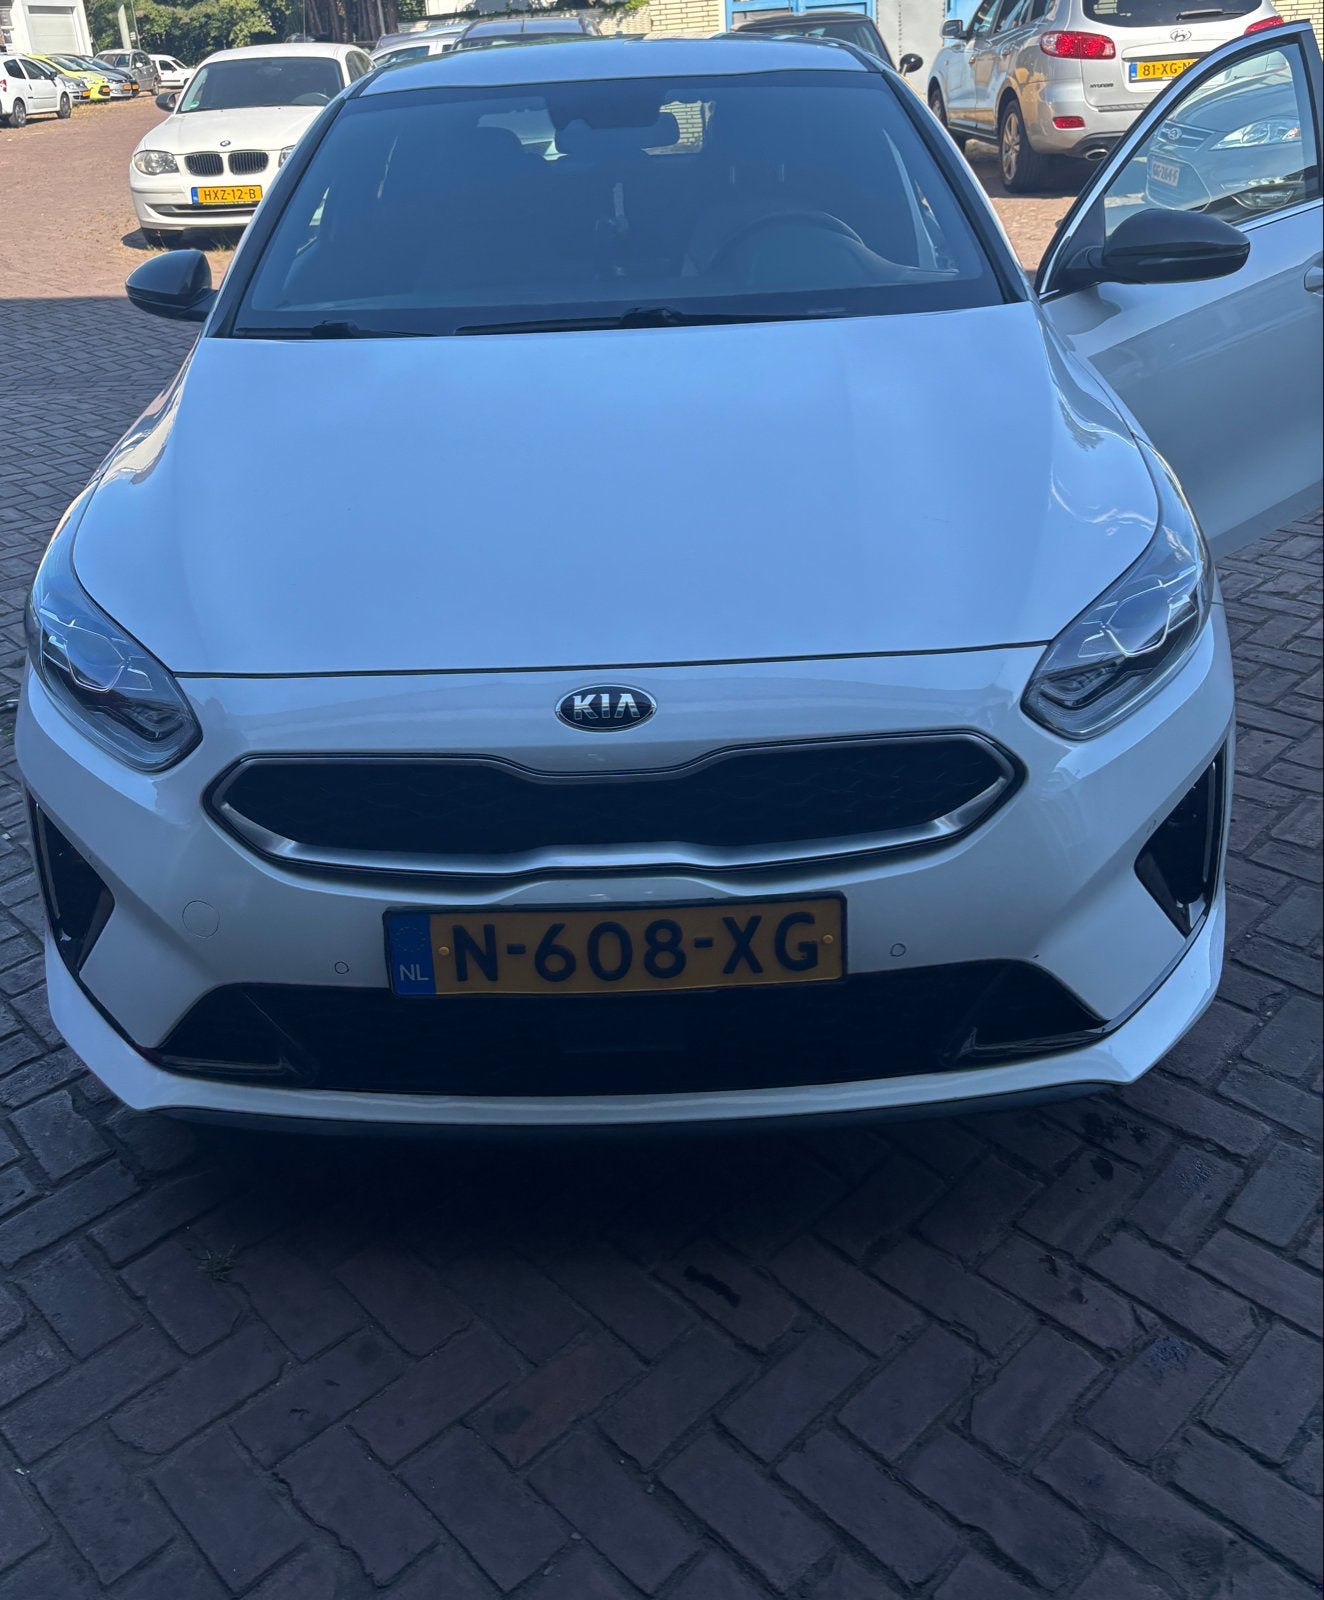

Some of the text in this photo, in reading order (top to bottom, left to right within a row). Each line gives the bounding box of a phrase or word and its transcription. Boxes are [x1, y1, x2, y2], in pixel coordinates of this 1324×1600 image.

[1143, 62, 1191, 76] 81-XG-N
[203, 188, 257, 201] HXZ-12-B
[572, 693, 641, 720] KIA
[399, 912, 819, 983] NL N-608-XG
